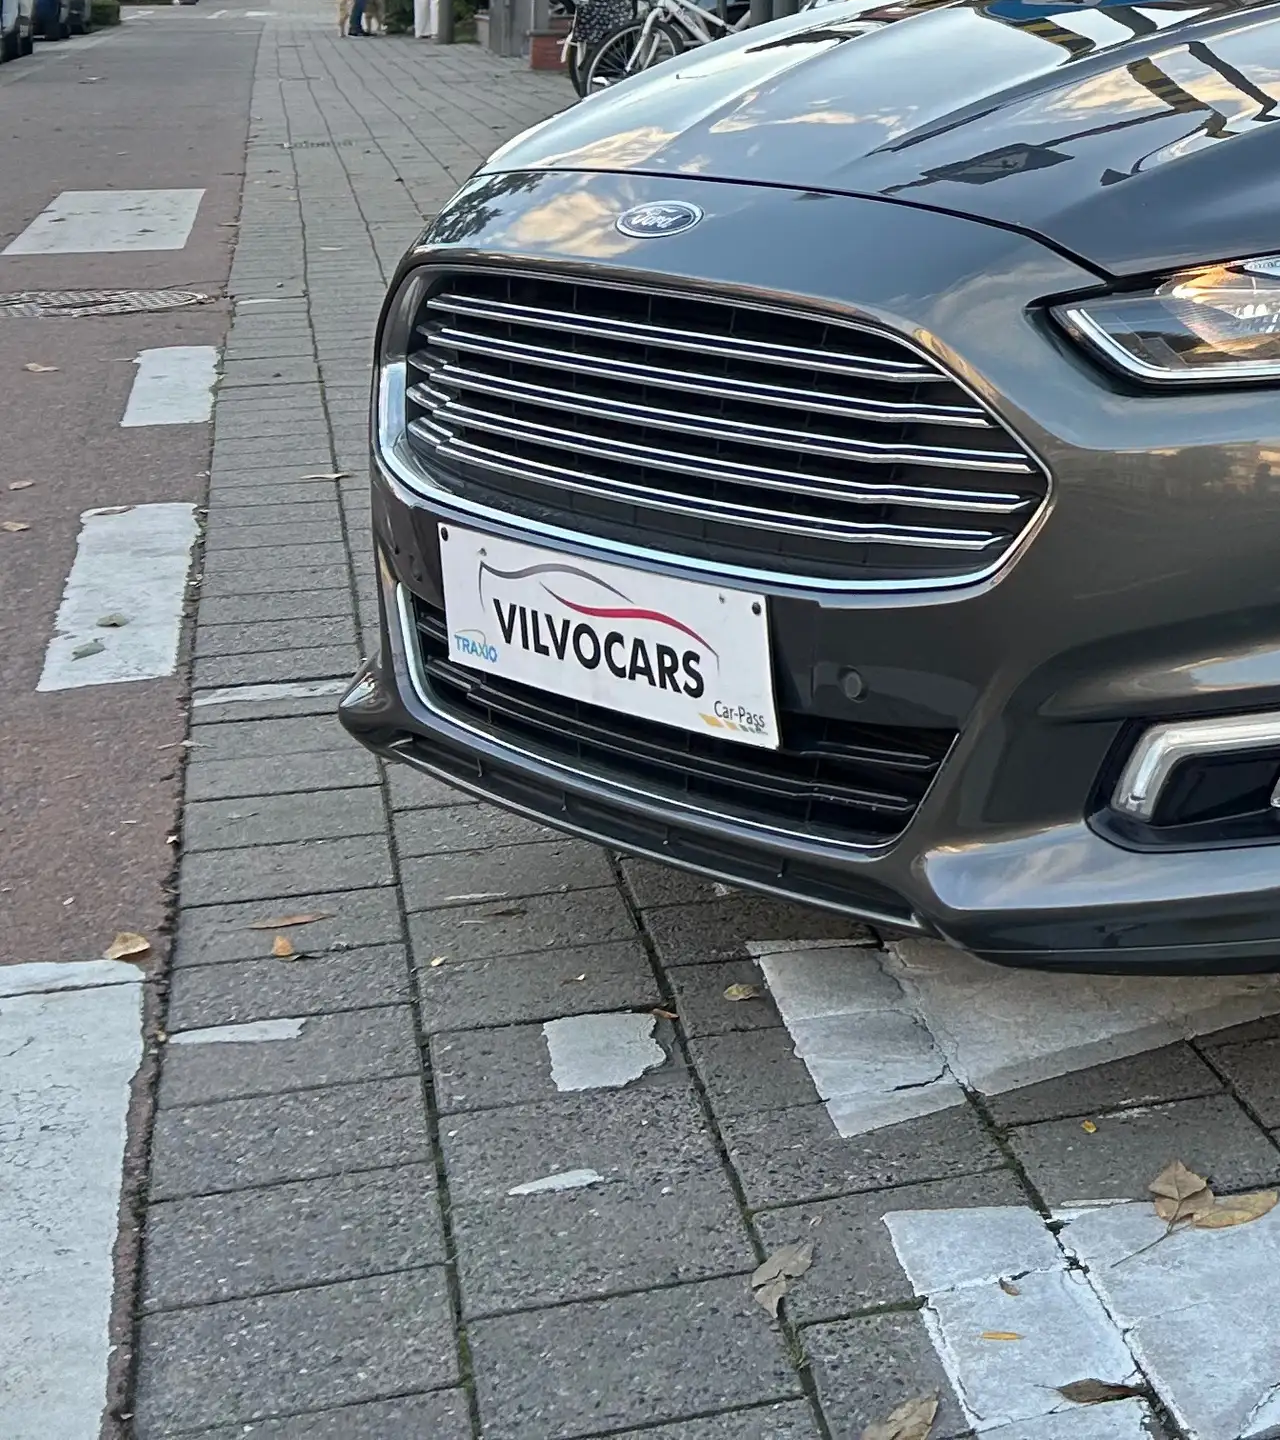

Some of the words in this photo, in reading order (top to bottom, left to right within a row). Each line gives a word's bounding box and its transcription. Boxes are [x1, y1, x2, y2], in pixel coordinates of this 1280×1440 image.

[627, 206, 684, 229] Ford
[454, 630, 498, 664] TRAXIO
[493, 598, 705, 699] VILVOCARS
[714, 700, 765, 728] Car-Pass
